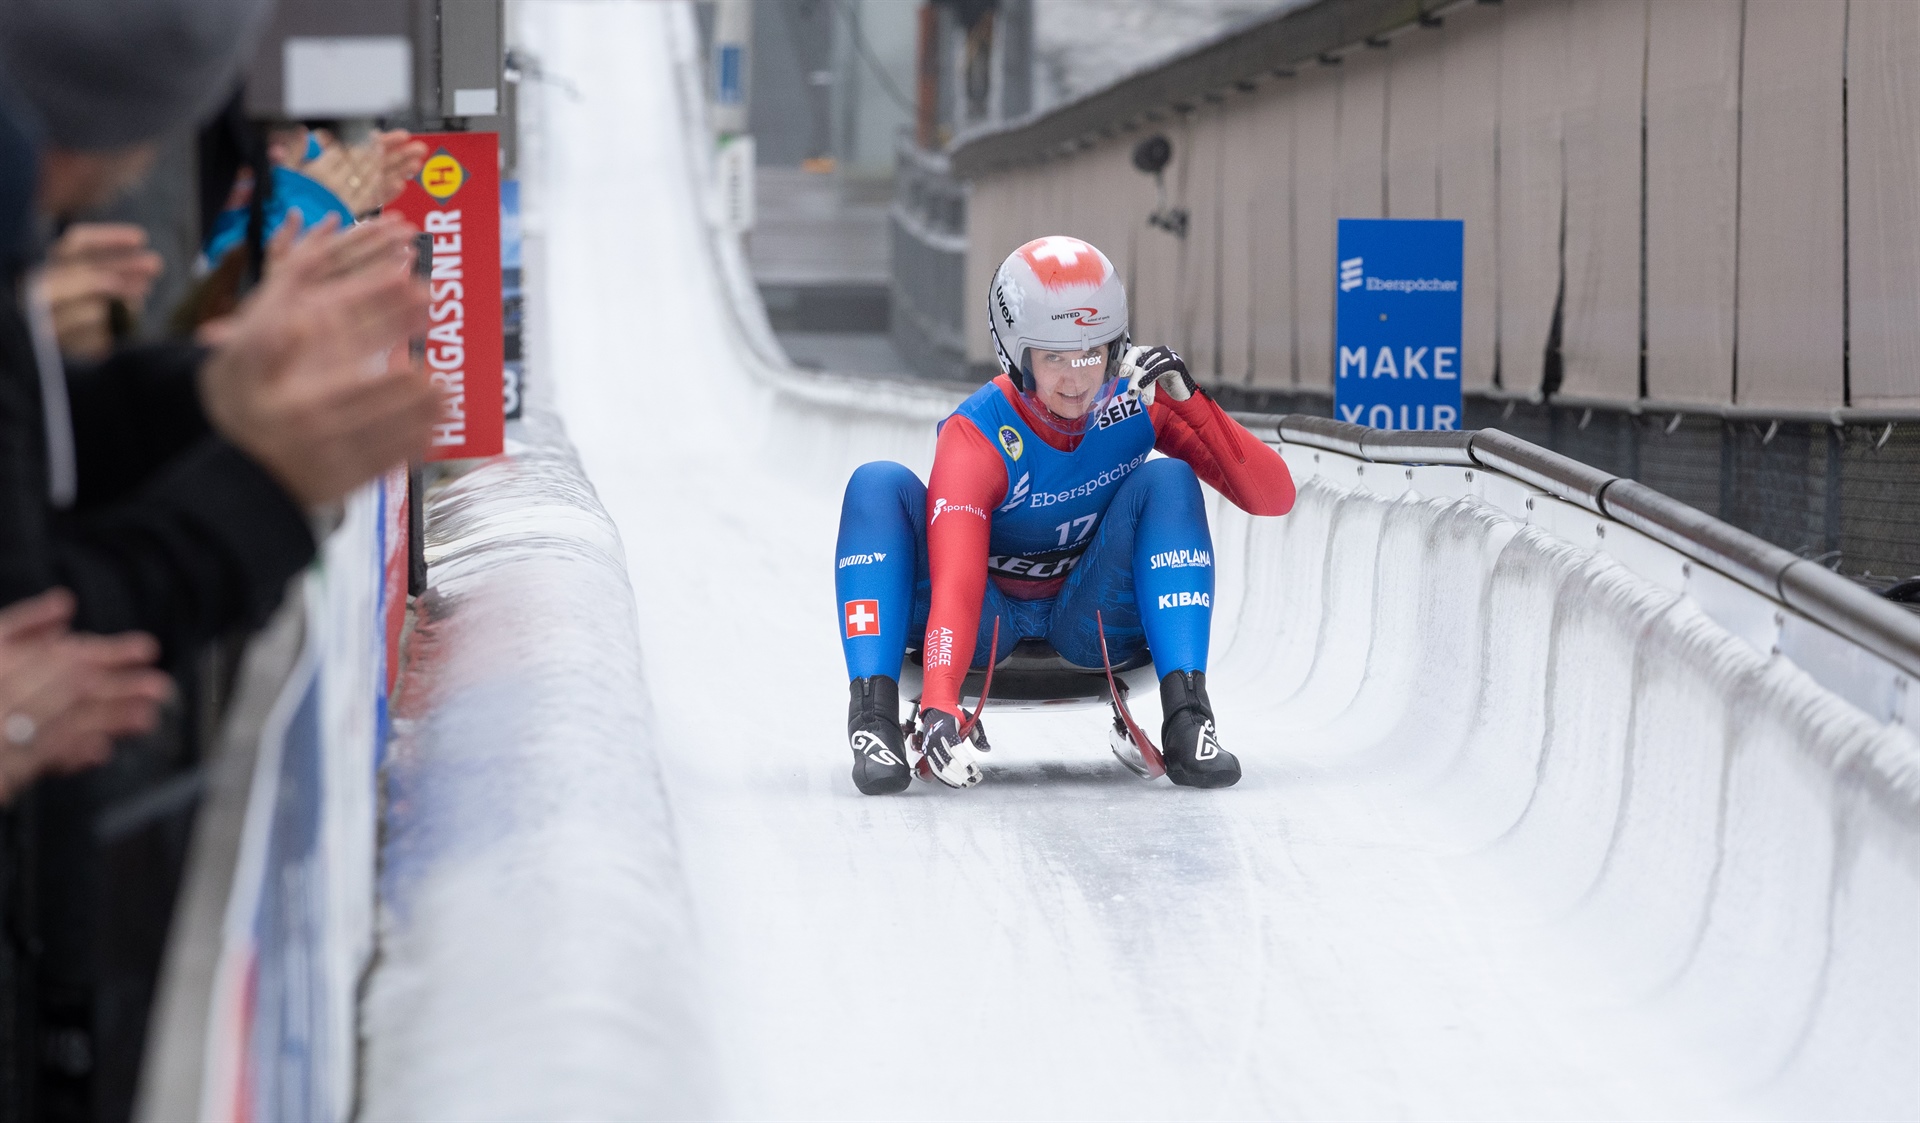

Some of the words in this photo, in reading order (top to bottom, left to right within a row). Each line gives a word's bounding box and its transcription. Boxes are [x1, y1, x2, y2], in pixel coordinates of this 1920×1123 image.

[996, 285, 1015, 329] uvex
[1051, 311, 1080, 321] UNITED
[425, 209, 465, 447] HARGASSNER
[1071, 354, 1102, 368] uvex
[1339, 345, 1457, 380] MAKE
[1339, 404, 1458, 430] YOUR
[1030, 453, 1145, 508] Eberspächer
[943, 504, 987, 521] sporthilfe
[1055, 513, 1098, 546] 17
[1150, 548, 1211, 569] SILVAPLANA
[1158, 591, 1210, 610] KIBAG
[927, 629, 939, 672] SUISSE
[938, 626, 954, 667] ARMEE
[851, 730, 905, 766] GTS
